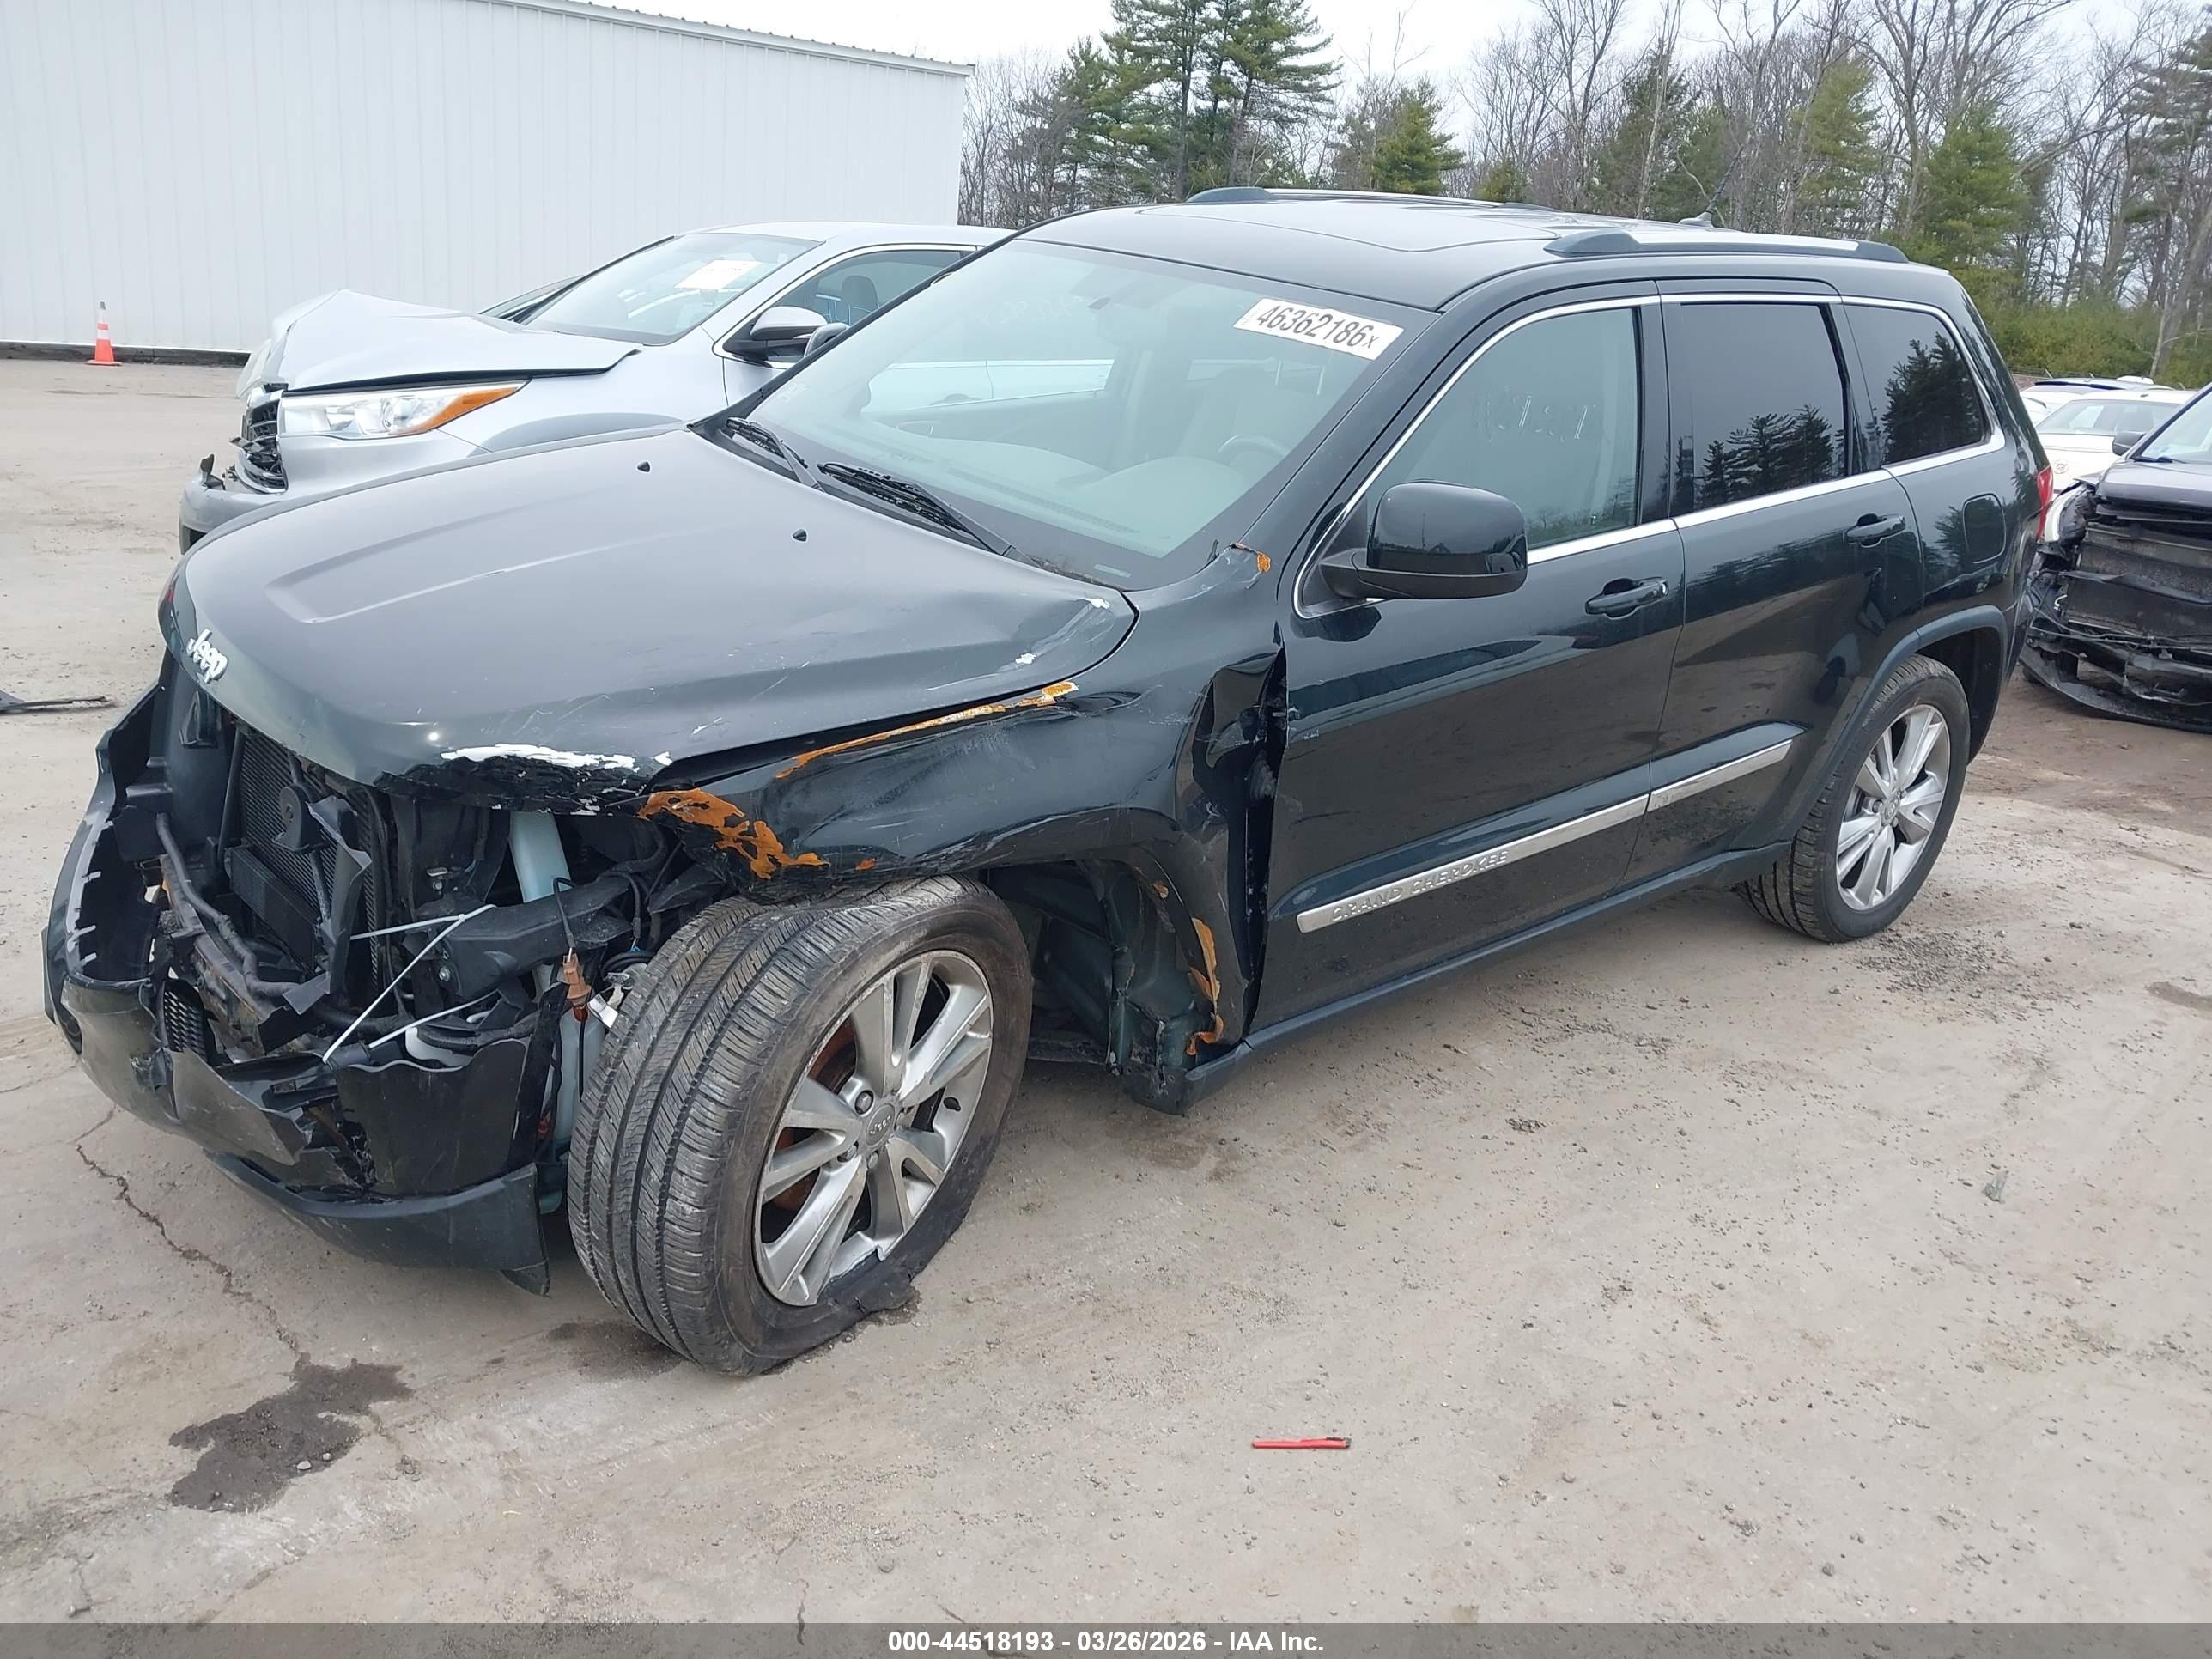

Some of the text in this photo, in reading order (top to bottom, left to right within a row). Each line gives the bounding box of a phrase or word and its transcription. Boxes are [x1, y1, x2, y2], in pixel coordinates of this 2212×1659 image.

[186, 628, 228, 684] Jeep
[1332, 851, 1509, 922] GRAND CHEROKEE
